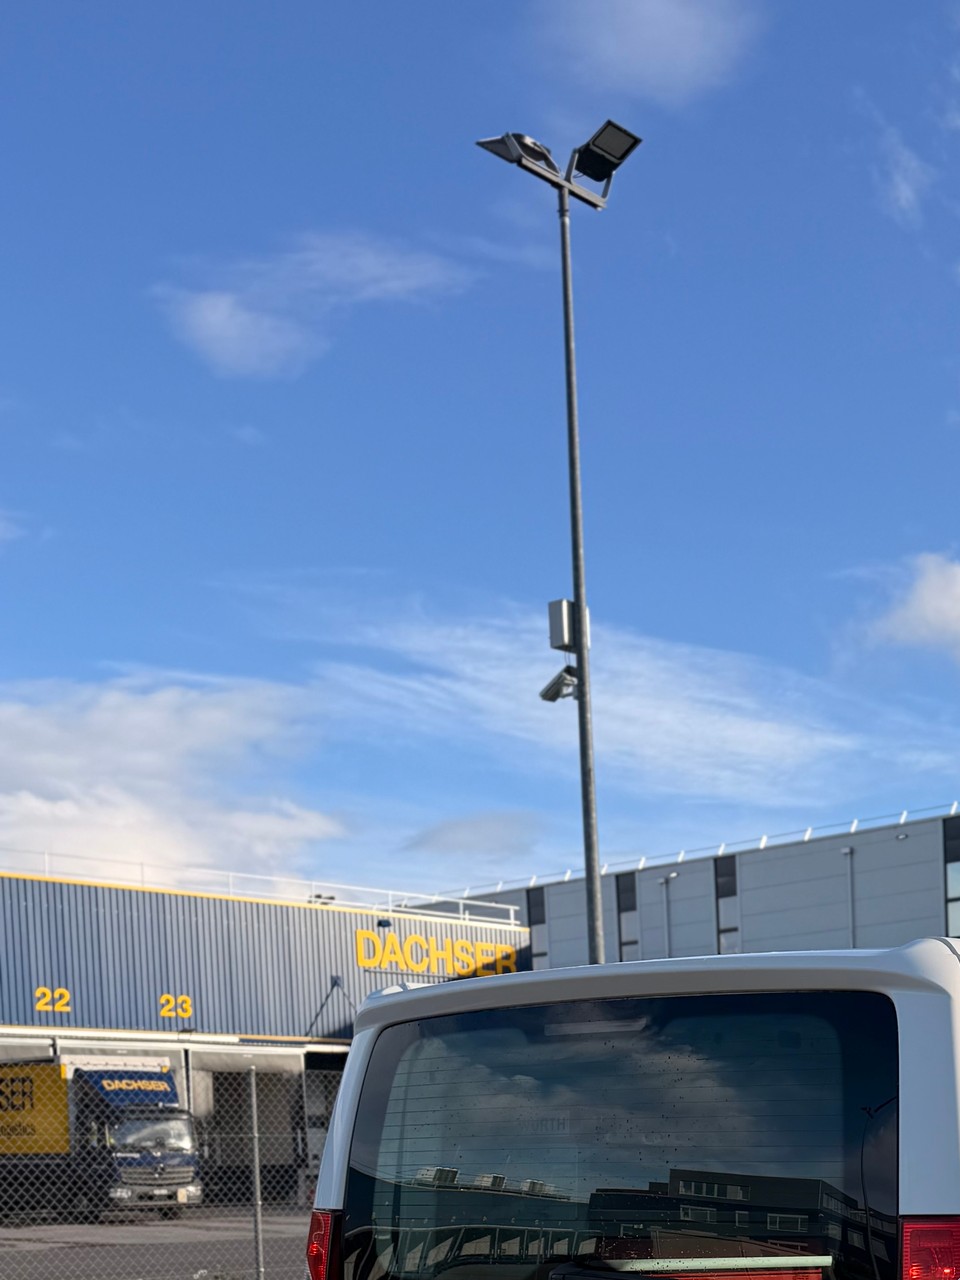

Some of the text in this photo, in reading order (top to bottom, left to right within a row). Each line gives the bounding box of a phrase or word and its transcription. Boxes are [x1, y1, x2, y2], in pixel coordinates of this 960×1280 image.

[356, 928, 518, 977] DACHSER
[34, 986, 72, 1013] 22
[159, 993, 193, 1019] 23
[101, 1079, 171, 1093] DACHSER
